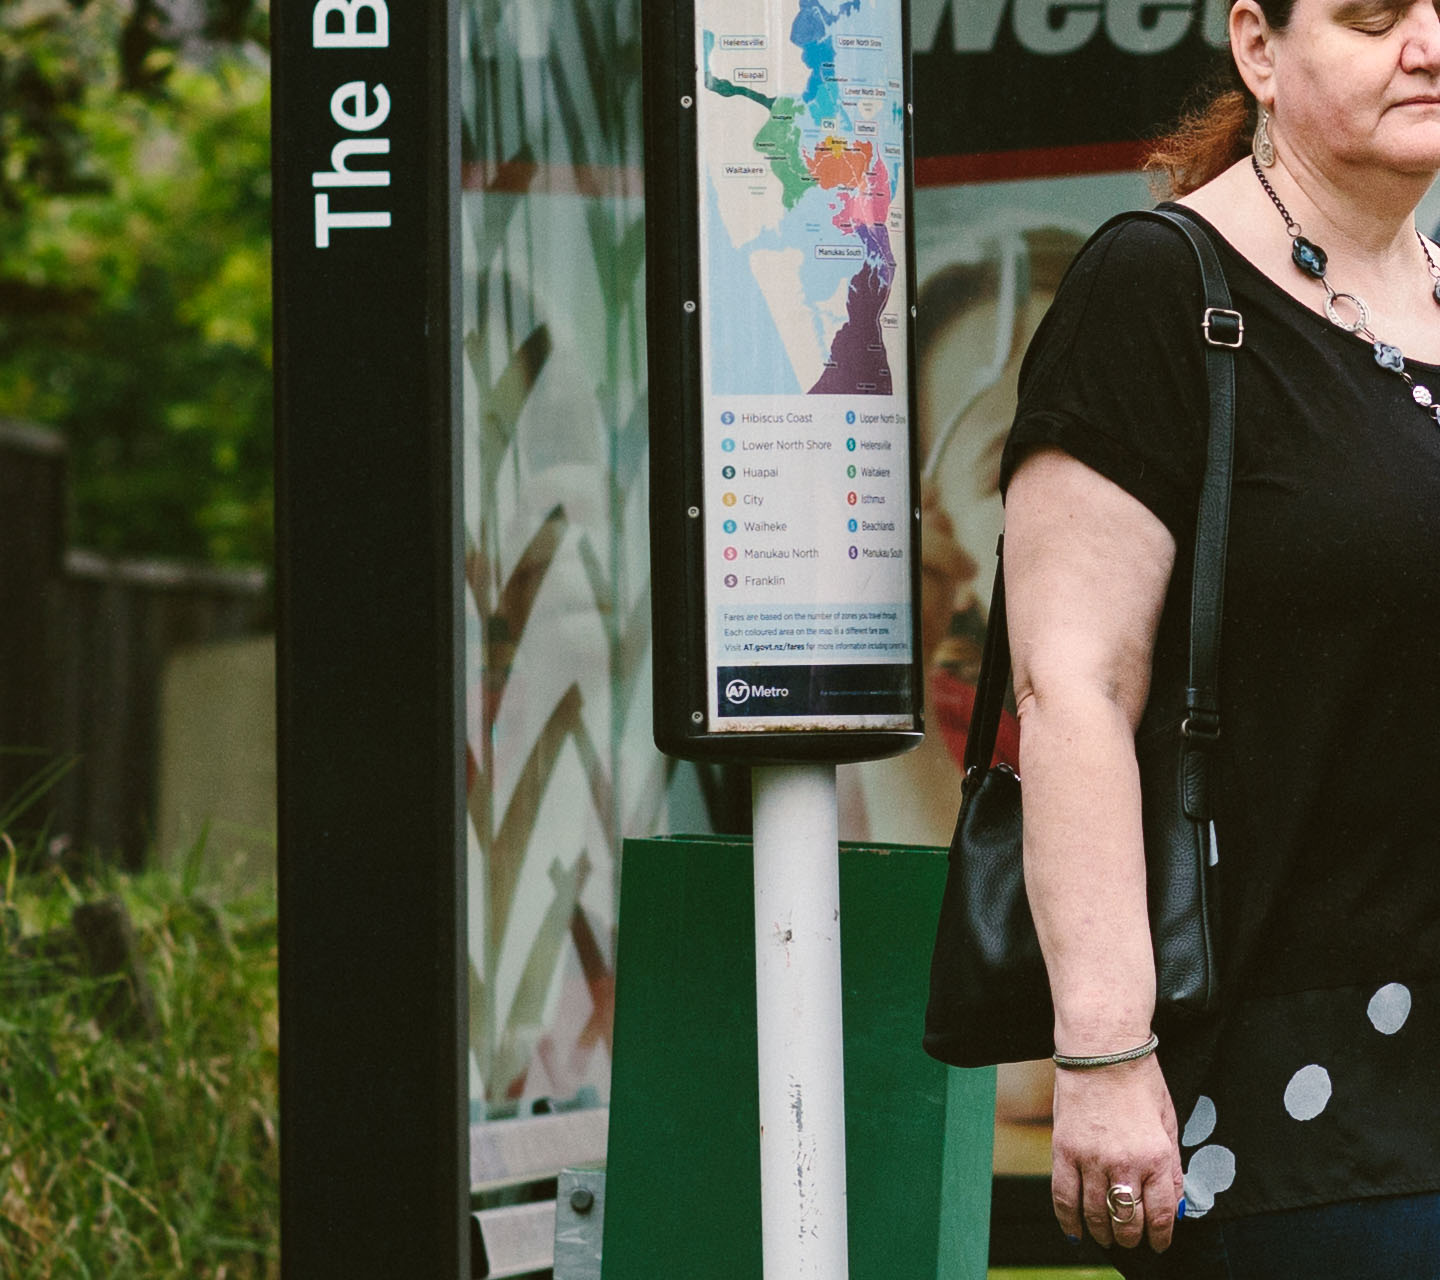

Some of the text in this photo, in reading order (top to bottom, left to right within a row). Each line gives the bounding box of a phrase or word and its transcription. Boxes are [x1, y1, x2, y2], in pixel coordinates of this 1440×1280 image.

[312, 81, 390, 247] The
[741, 412, 813, 423] Hibiscus Coast
[742, 440, 832, 451] Lower North Shore
[743, 467, 779, 478] Huapai
[743, 494, 764, 506] City
[744, 521, 787, 531] Waiheke
[744, 548, 819, 558] Manukau North
[745, 575, 785, 586] Franklin
[724, 628, 743, 636] Each
[744, 628, 777, 636] coloured
[724, 643, 741, 651] Visit
[726, 681, 789, 701] AT Metro
